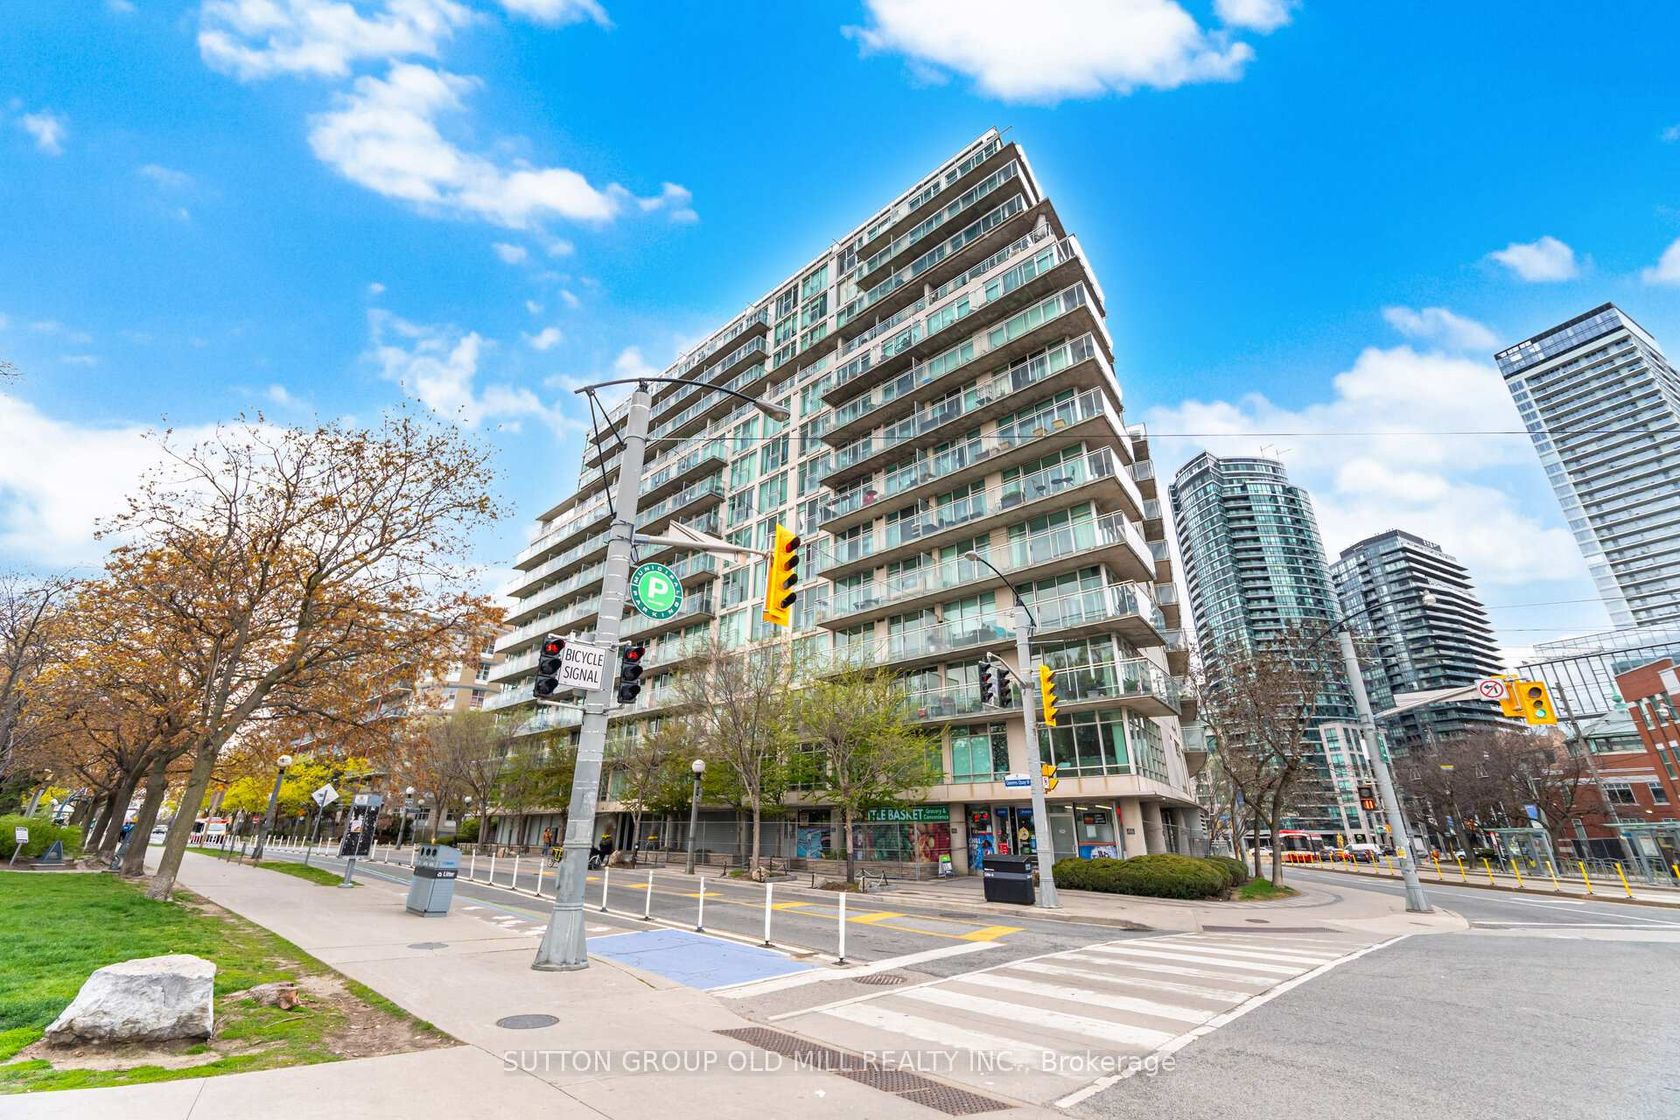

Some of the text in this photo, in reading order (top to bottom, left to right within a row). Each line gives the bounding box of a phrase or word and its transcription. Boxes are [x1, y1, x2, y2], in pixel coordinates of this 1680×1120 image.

[634, 565, 680, 596] MUNICIPAL
[648, 577, 669, 598] P
[633, 590, 680, 618] PARKING
[565, 648, 603, 666] BICYCLE
[563, 665, 599, 683] SIGNAL
[888, 808, 923, 820] BASKET
